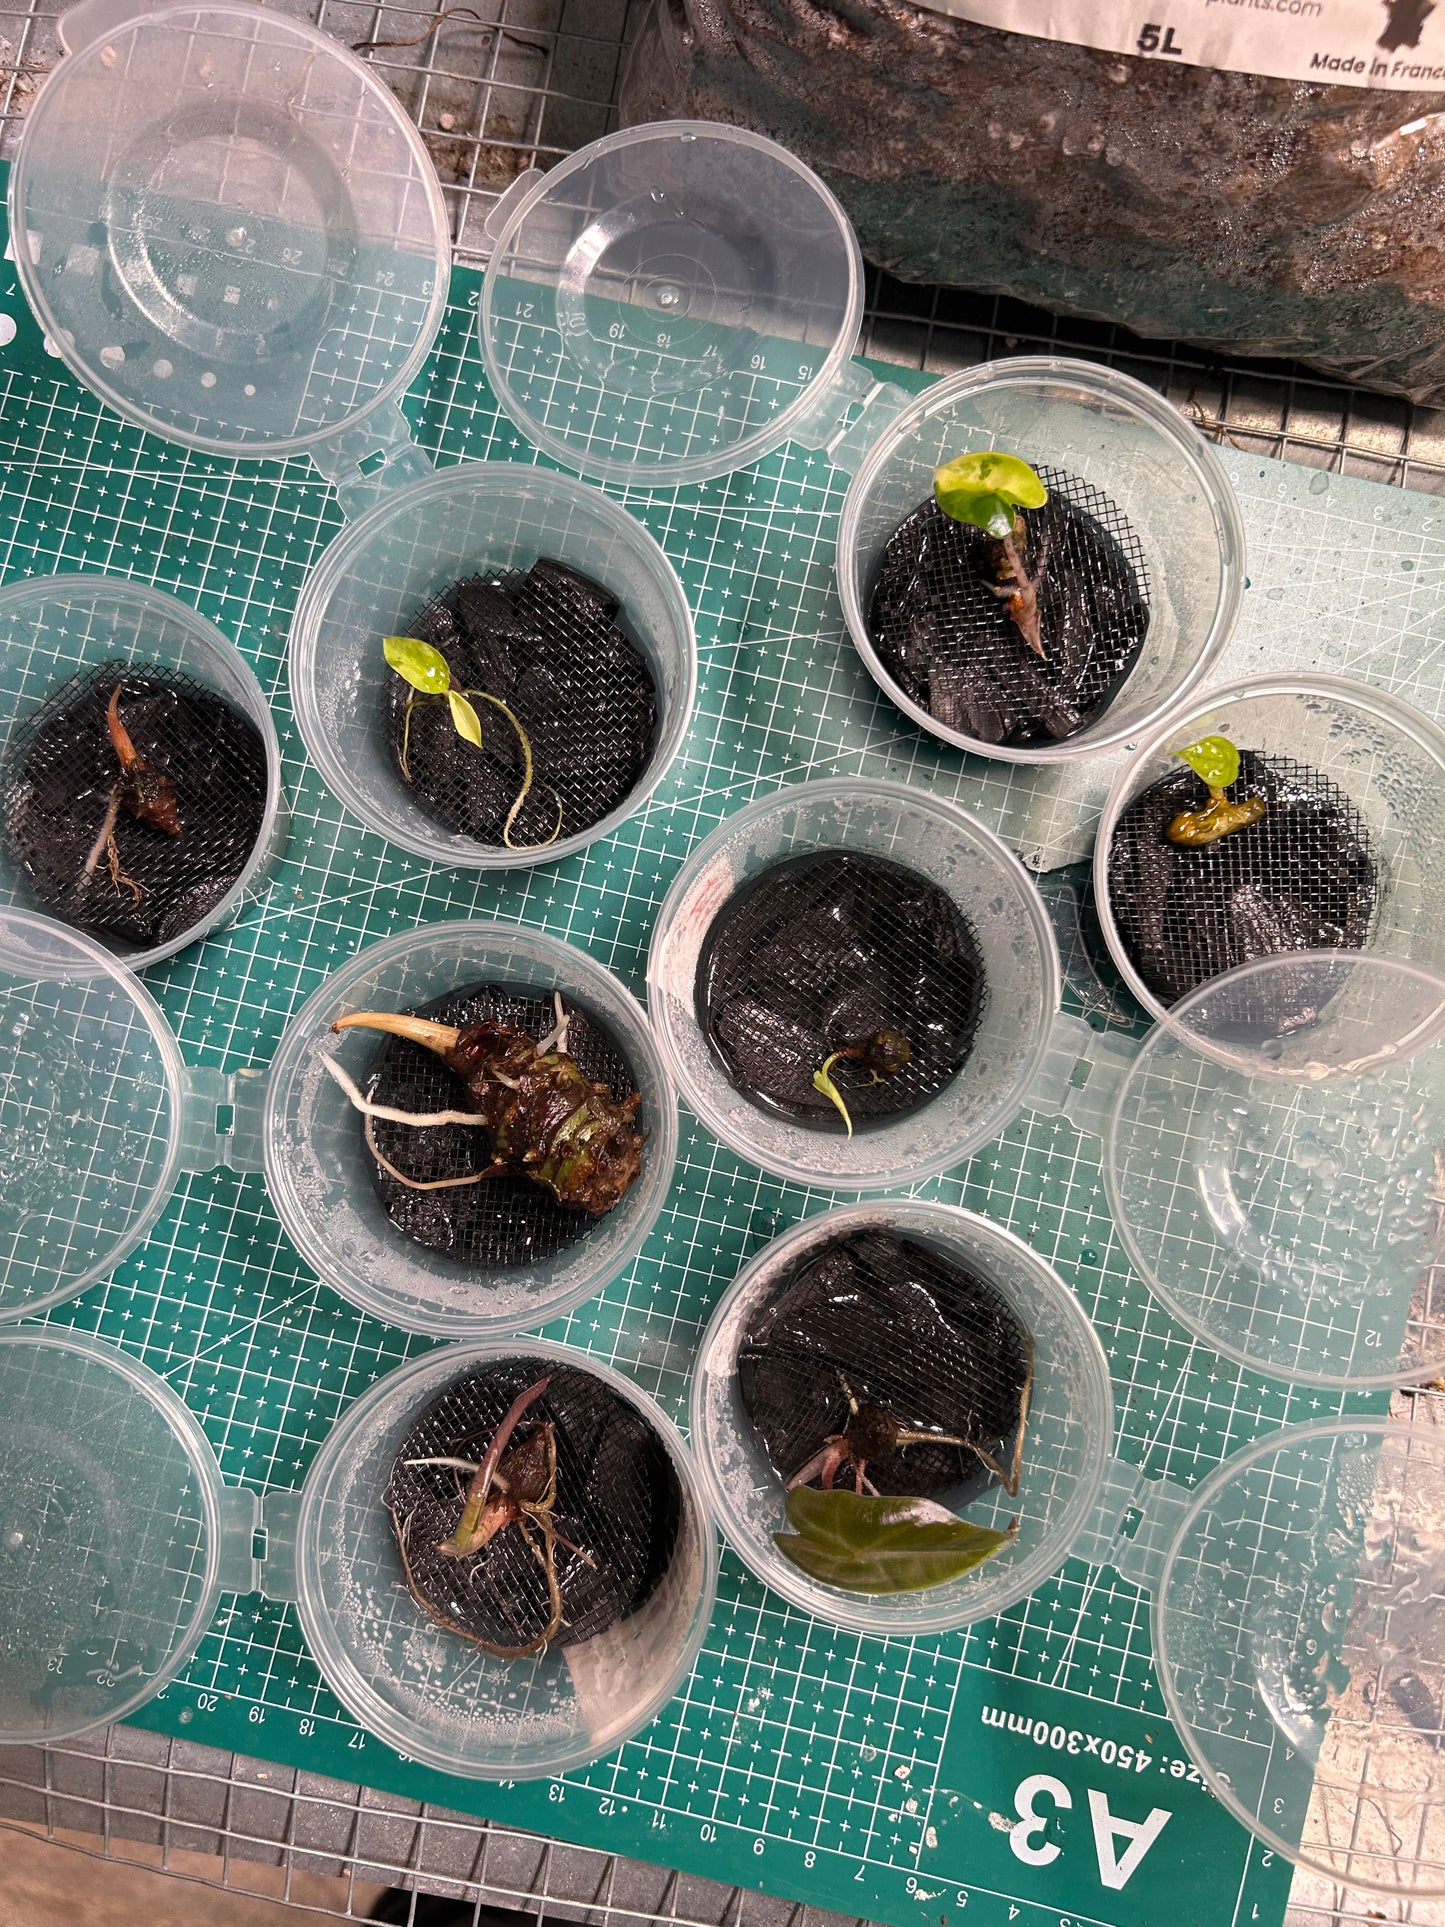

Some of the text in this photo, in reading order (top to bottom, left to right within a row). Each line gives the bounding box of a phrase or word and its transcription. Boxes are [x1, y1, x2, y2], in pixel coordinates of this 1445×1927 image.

[1136, 23, 1183, 55] 5L
[1309, 52, 1367, 74] Made
[515, 301, 535, 320] 21
[608, 322, 626, 340] 19
[701, 344, 719, 358] 17
[750, 353, 767, 371] 16
[797, 364, 814, 381] 15
[1276, 483, 1288, 499] 5
[1326, 495, 1336, 509] 4
[1373, 505, 1385, 521] 3
[1421, 515, 1434, 532] 2
[1364, 1328, 1383, 1348] 12
[196, 1692, 220, 1713] 20
[249, 1704, 268, 1725] 19
[298, 1718, 316, 1738] 18
[347, 1732, 367, 1751] 17
[981, 1704, 1152, 1774] 450x300mm
[548, 1783, 566, 1804] 13
[598, 1796, 617, 1817] 12
[1273, 1797, 1285, 1815] 3
[651, 1809, 667, 1830] 11
[699, 1822, 719, 1843] 10
[1009, 1773, 1173, 1891] A3
[752, 1837, 766, 1856] 9
[803, 1849, 817, 1869] 8
[1261, 1849, 1274, 1868] 2
[853, 1863, 867, 1883] 7
[904, 1875, 919, 1895] 6
[955, 1889, 970, 1909] 5
[1008, 1903, 1022, 1921] 4
[1251, 1902, 1260, 1920] 1
